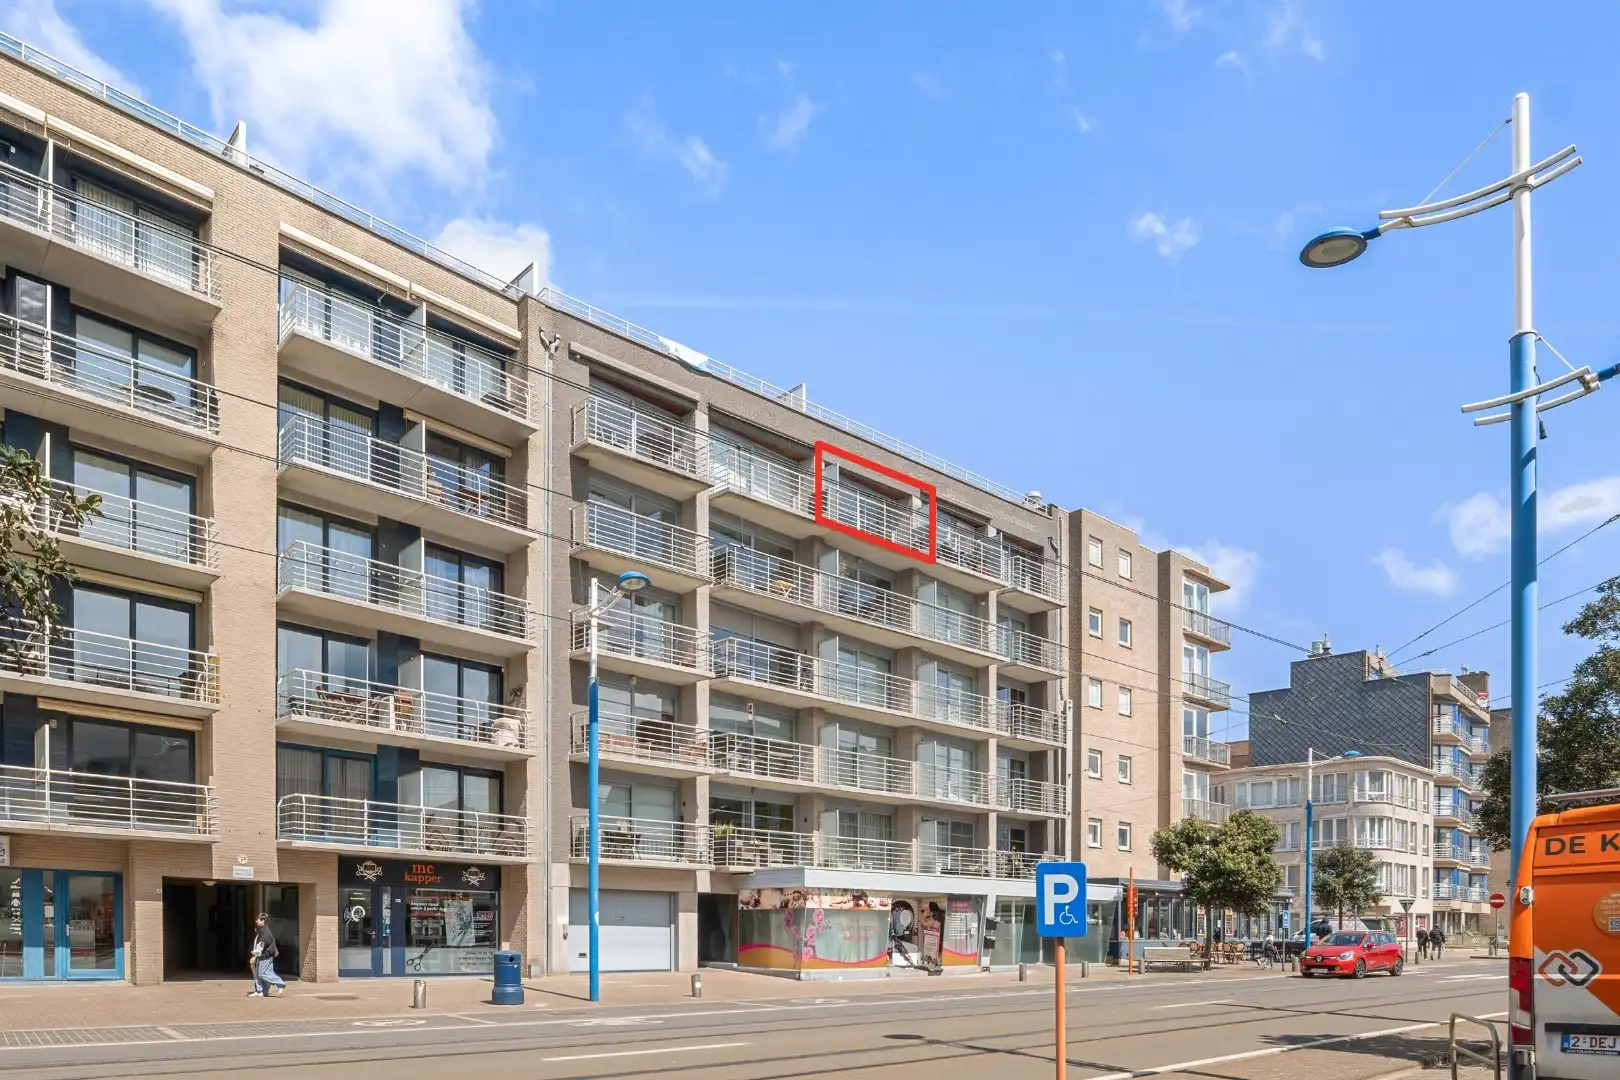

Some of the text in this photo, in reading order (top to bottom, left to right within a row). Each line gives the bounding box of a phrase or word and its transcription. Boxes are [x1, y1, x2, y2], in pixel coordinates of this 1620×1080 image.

[1545, 836, 1586, 856] DE
[404, 870, 443, 884] kapper
[412, 863, 435, 874] mc
[1044, 873, 1079, 925] P
